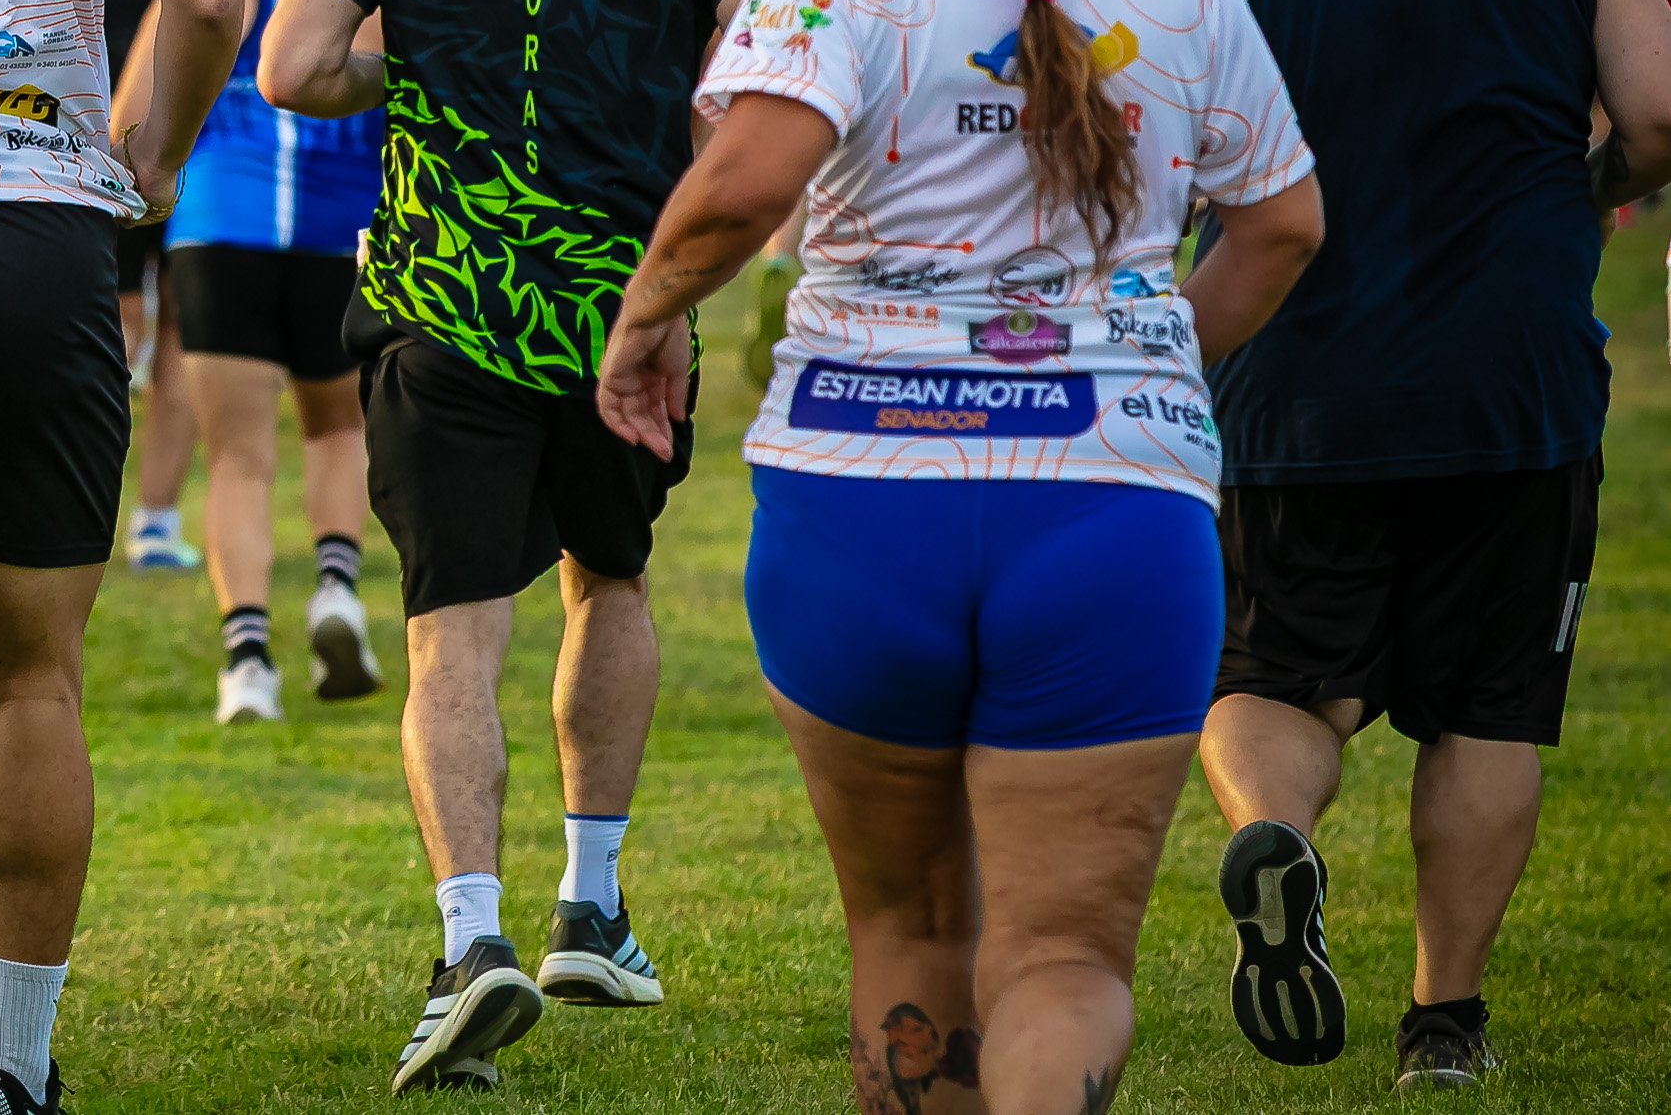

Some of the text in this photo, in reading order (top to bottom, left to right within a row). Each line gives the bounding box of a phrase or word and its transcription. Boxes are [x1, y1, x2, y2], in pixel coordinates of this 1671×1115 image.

[810, 370, 1070, 408] ESTEBAN MOTTA
[874, 408, 989, 430] SENADOR
